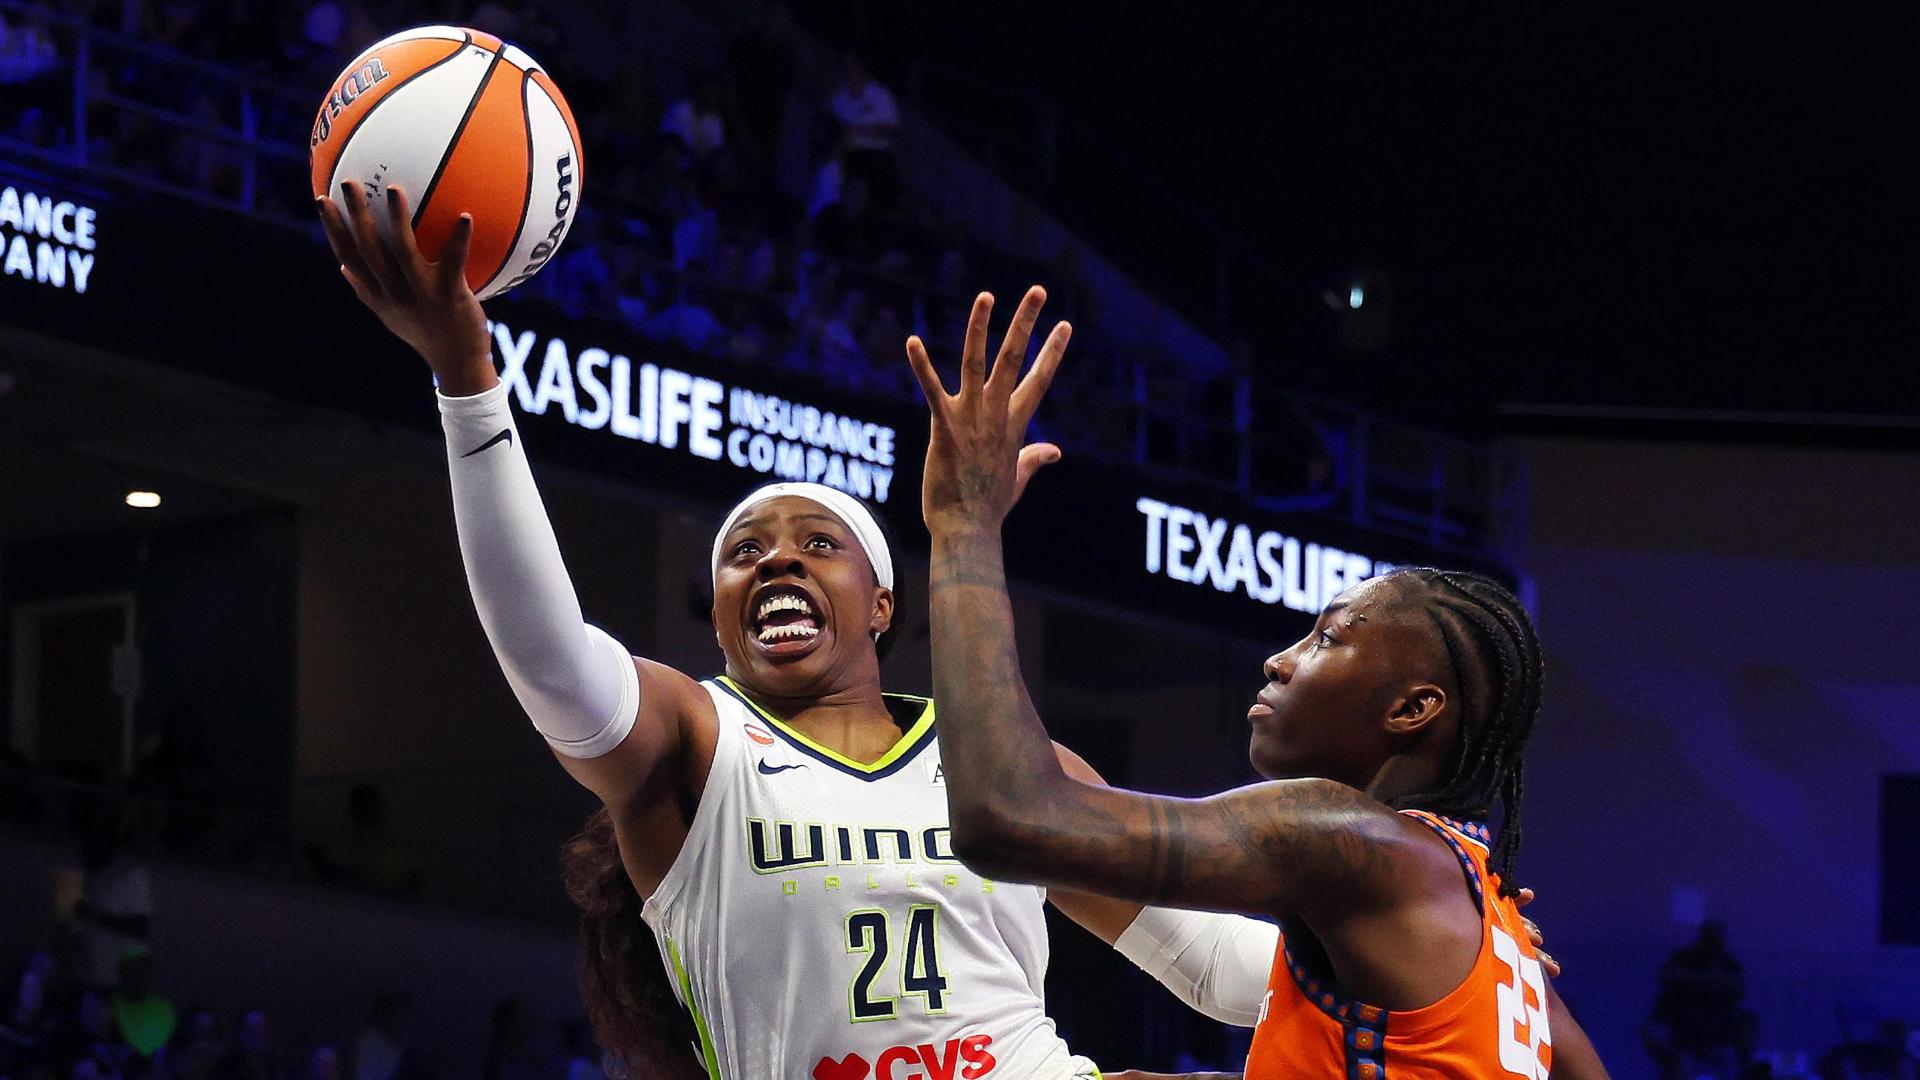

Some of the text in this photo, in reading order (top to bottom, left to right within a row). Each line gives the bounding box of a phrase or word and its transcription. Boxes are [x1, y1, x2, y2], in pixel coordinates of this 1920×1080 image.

[0, 232, 95, 294] ANY
[486, 318, 896, 466] XASLIFE INSURANCE
[727, 427, 894, 503] COMPANY
[782, 873, 994, 896] DALLAS
[844, 903, 951, 1024] 24
[1491, 924, 1552, 1080] 22
[875, 1034, 997, 1080] CVS
